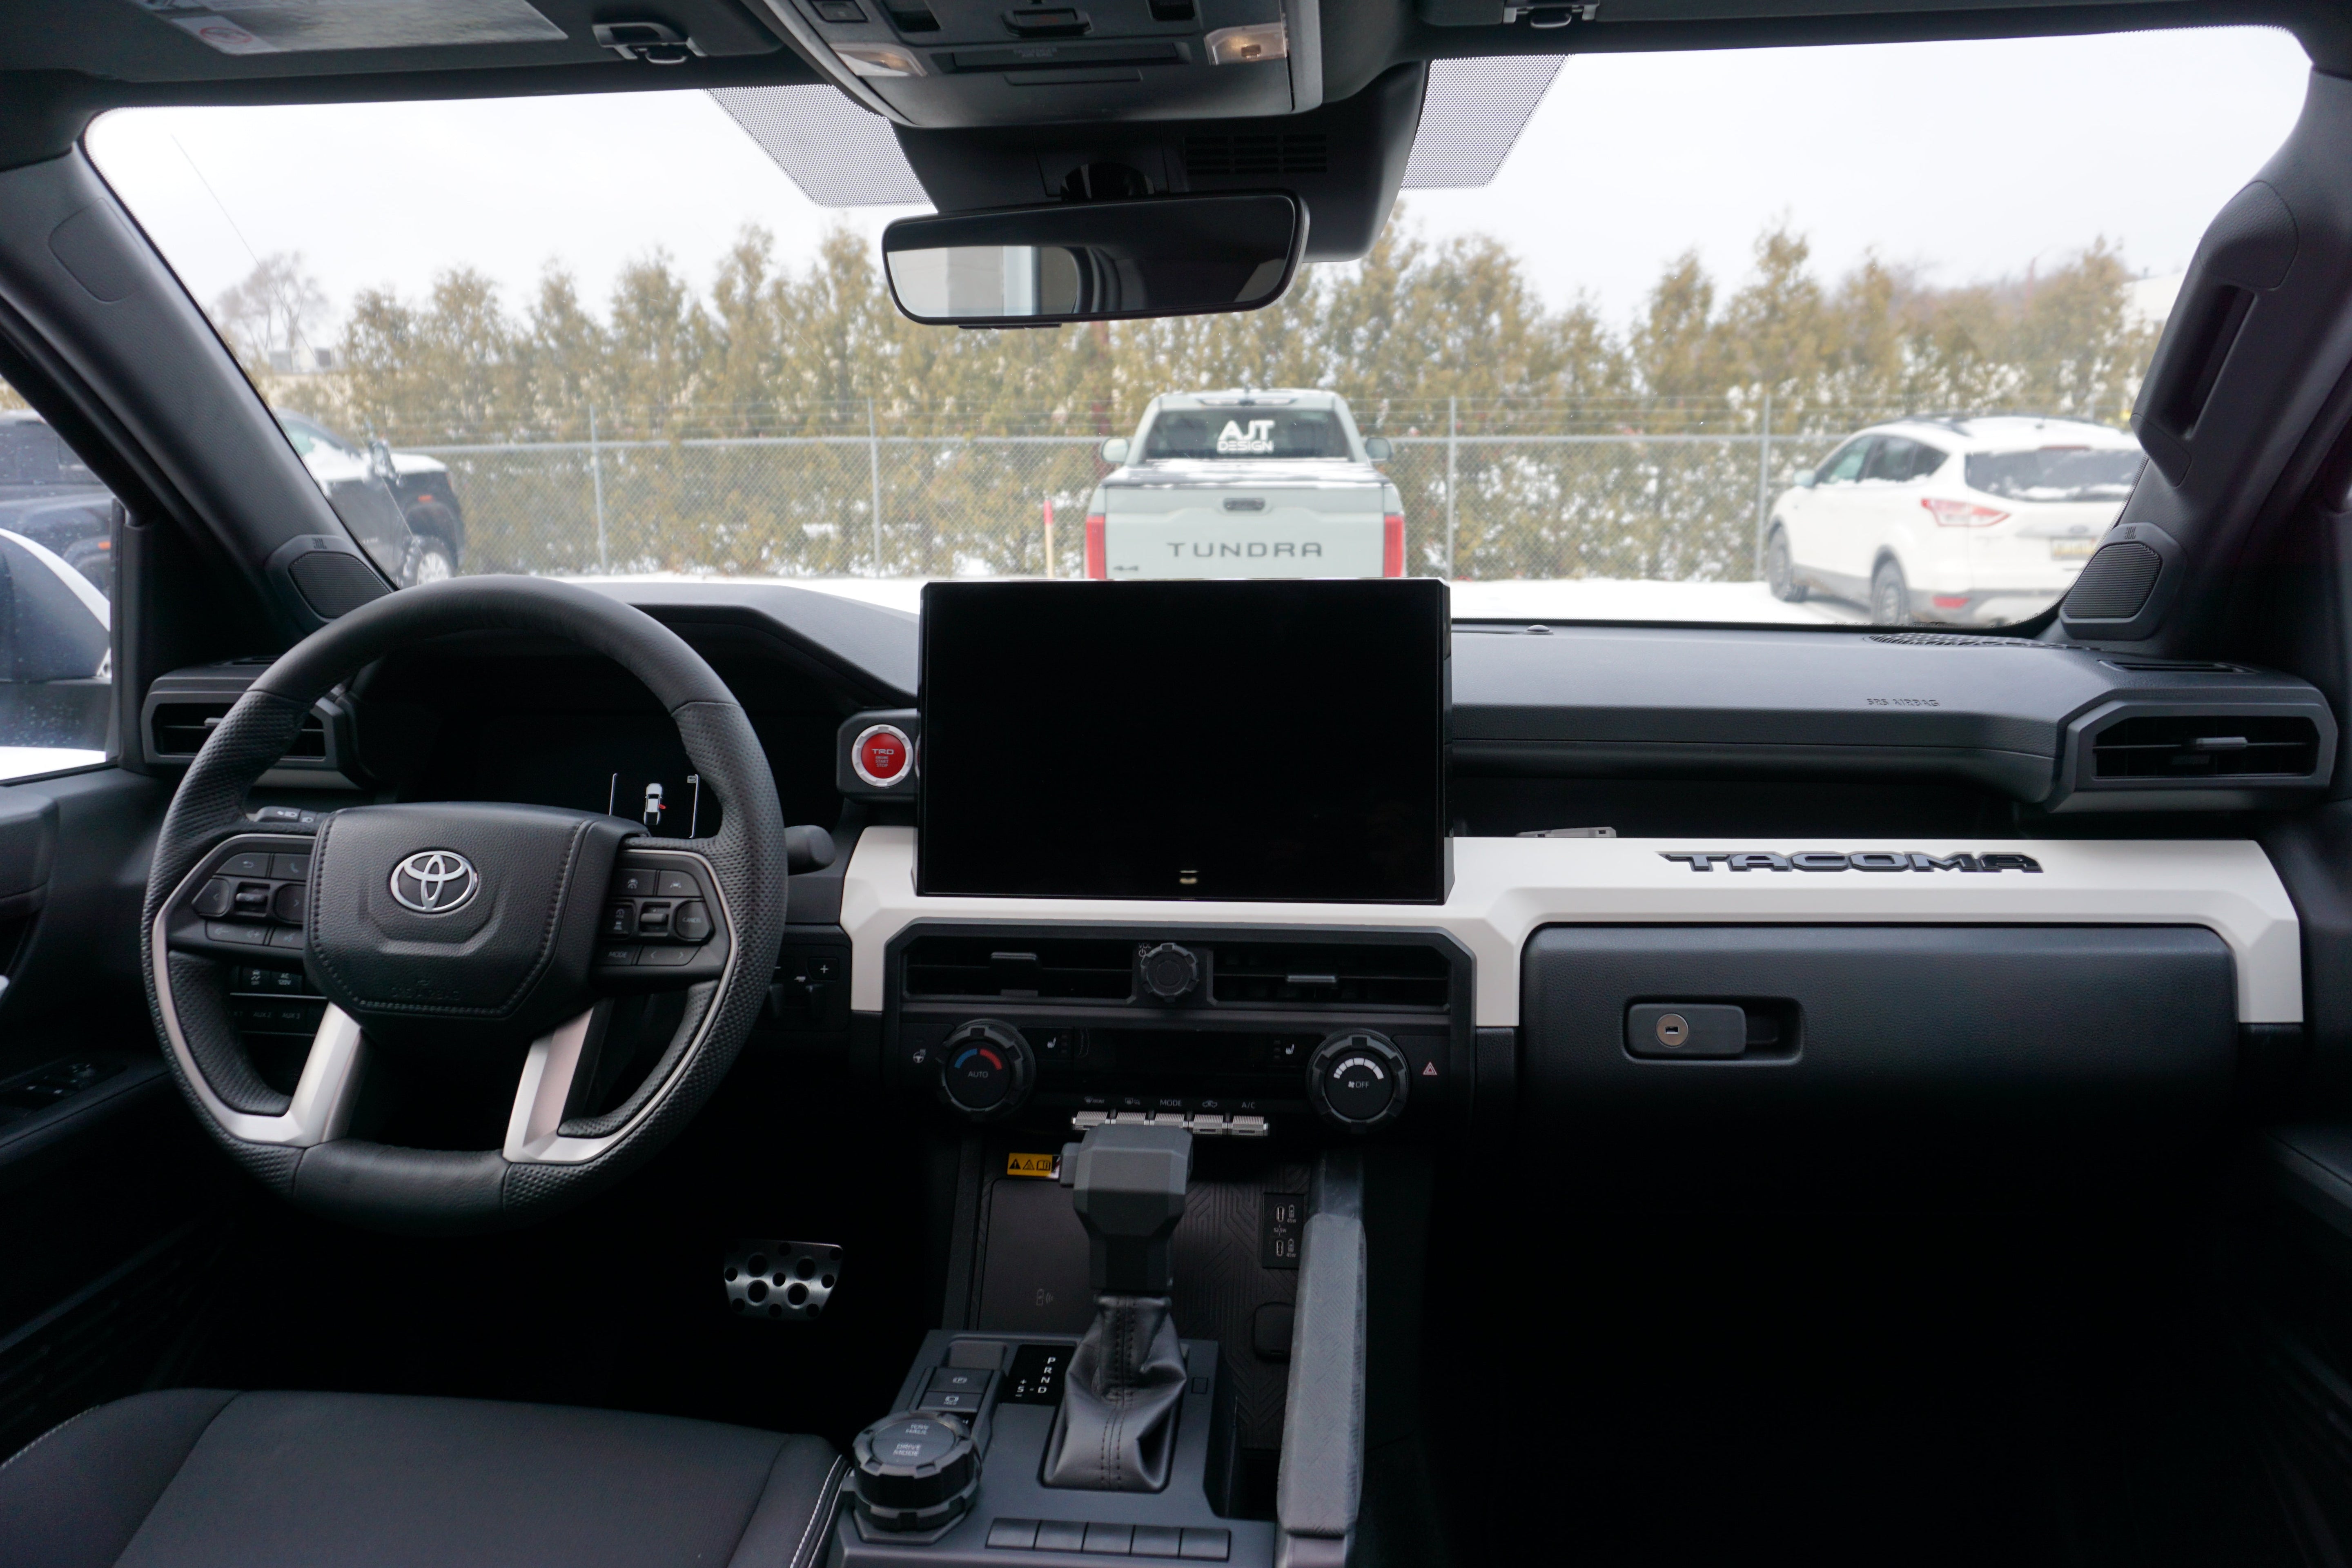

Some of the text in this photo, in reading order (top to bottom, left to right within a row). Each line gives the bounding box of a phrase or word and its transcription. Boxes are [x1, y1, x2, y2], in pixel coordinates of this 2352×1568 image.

[1218, 420, 1275, 441] AJT
[1217, 441, 1274, 453] DESIGN
[2125, 526, 2136, 539] JBL
[1166, 542, 1322, 557] TUNDRA
[1893, 698, 1940, 706] AIRBAG
[1656, 851, 2044, 873] TACOMA
[1160, 1099, 1183, 1107] MODE
[1047, 1356, 1056, 1365] P
[1043, 1366, 1052, 1374] R
[1016, 1385, 1047, 1394] S D
